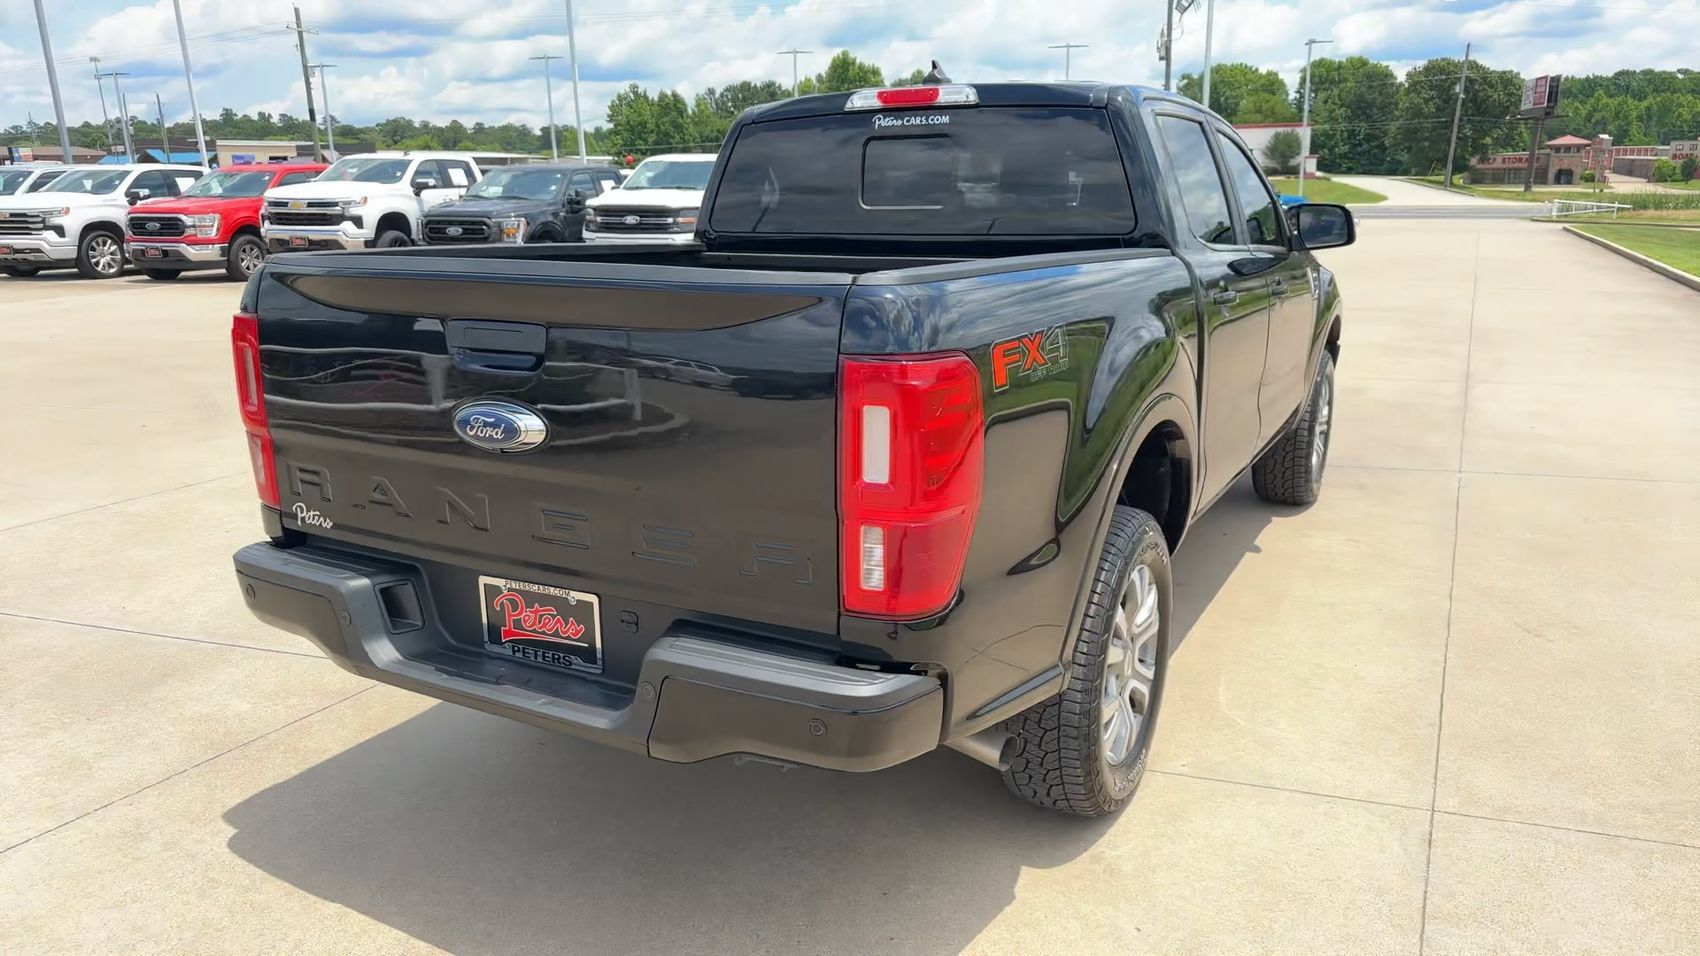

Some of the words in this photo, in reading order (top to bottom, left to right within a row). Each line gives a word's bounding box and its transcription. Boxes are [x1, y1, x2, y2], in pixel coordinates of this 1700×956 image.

[872, 115, 903, 130] Peters
[904, 115, 950, 125] CARS.COM
[990, 324, 1069, 392] FX4
[466, 414, 505, 440] Ford
[287, 460, 812, 585] RANGER
[292, 502, 334, 530] Peters
[504, 579, 571, 598] PETERSCARS.COM
[493, 592, 586, 640] Peters
[511, 644, 573, 667] PETERS
